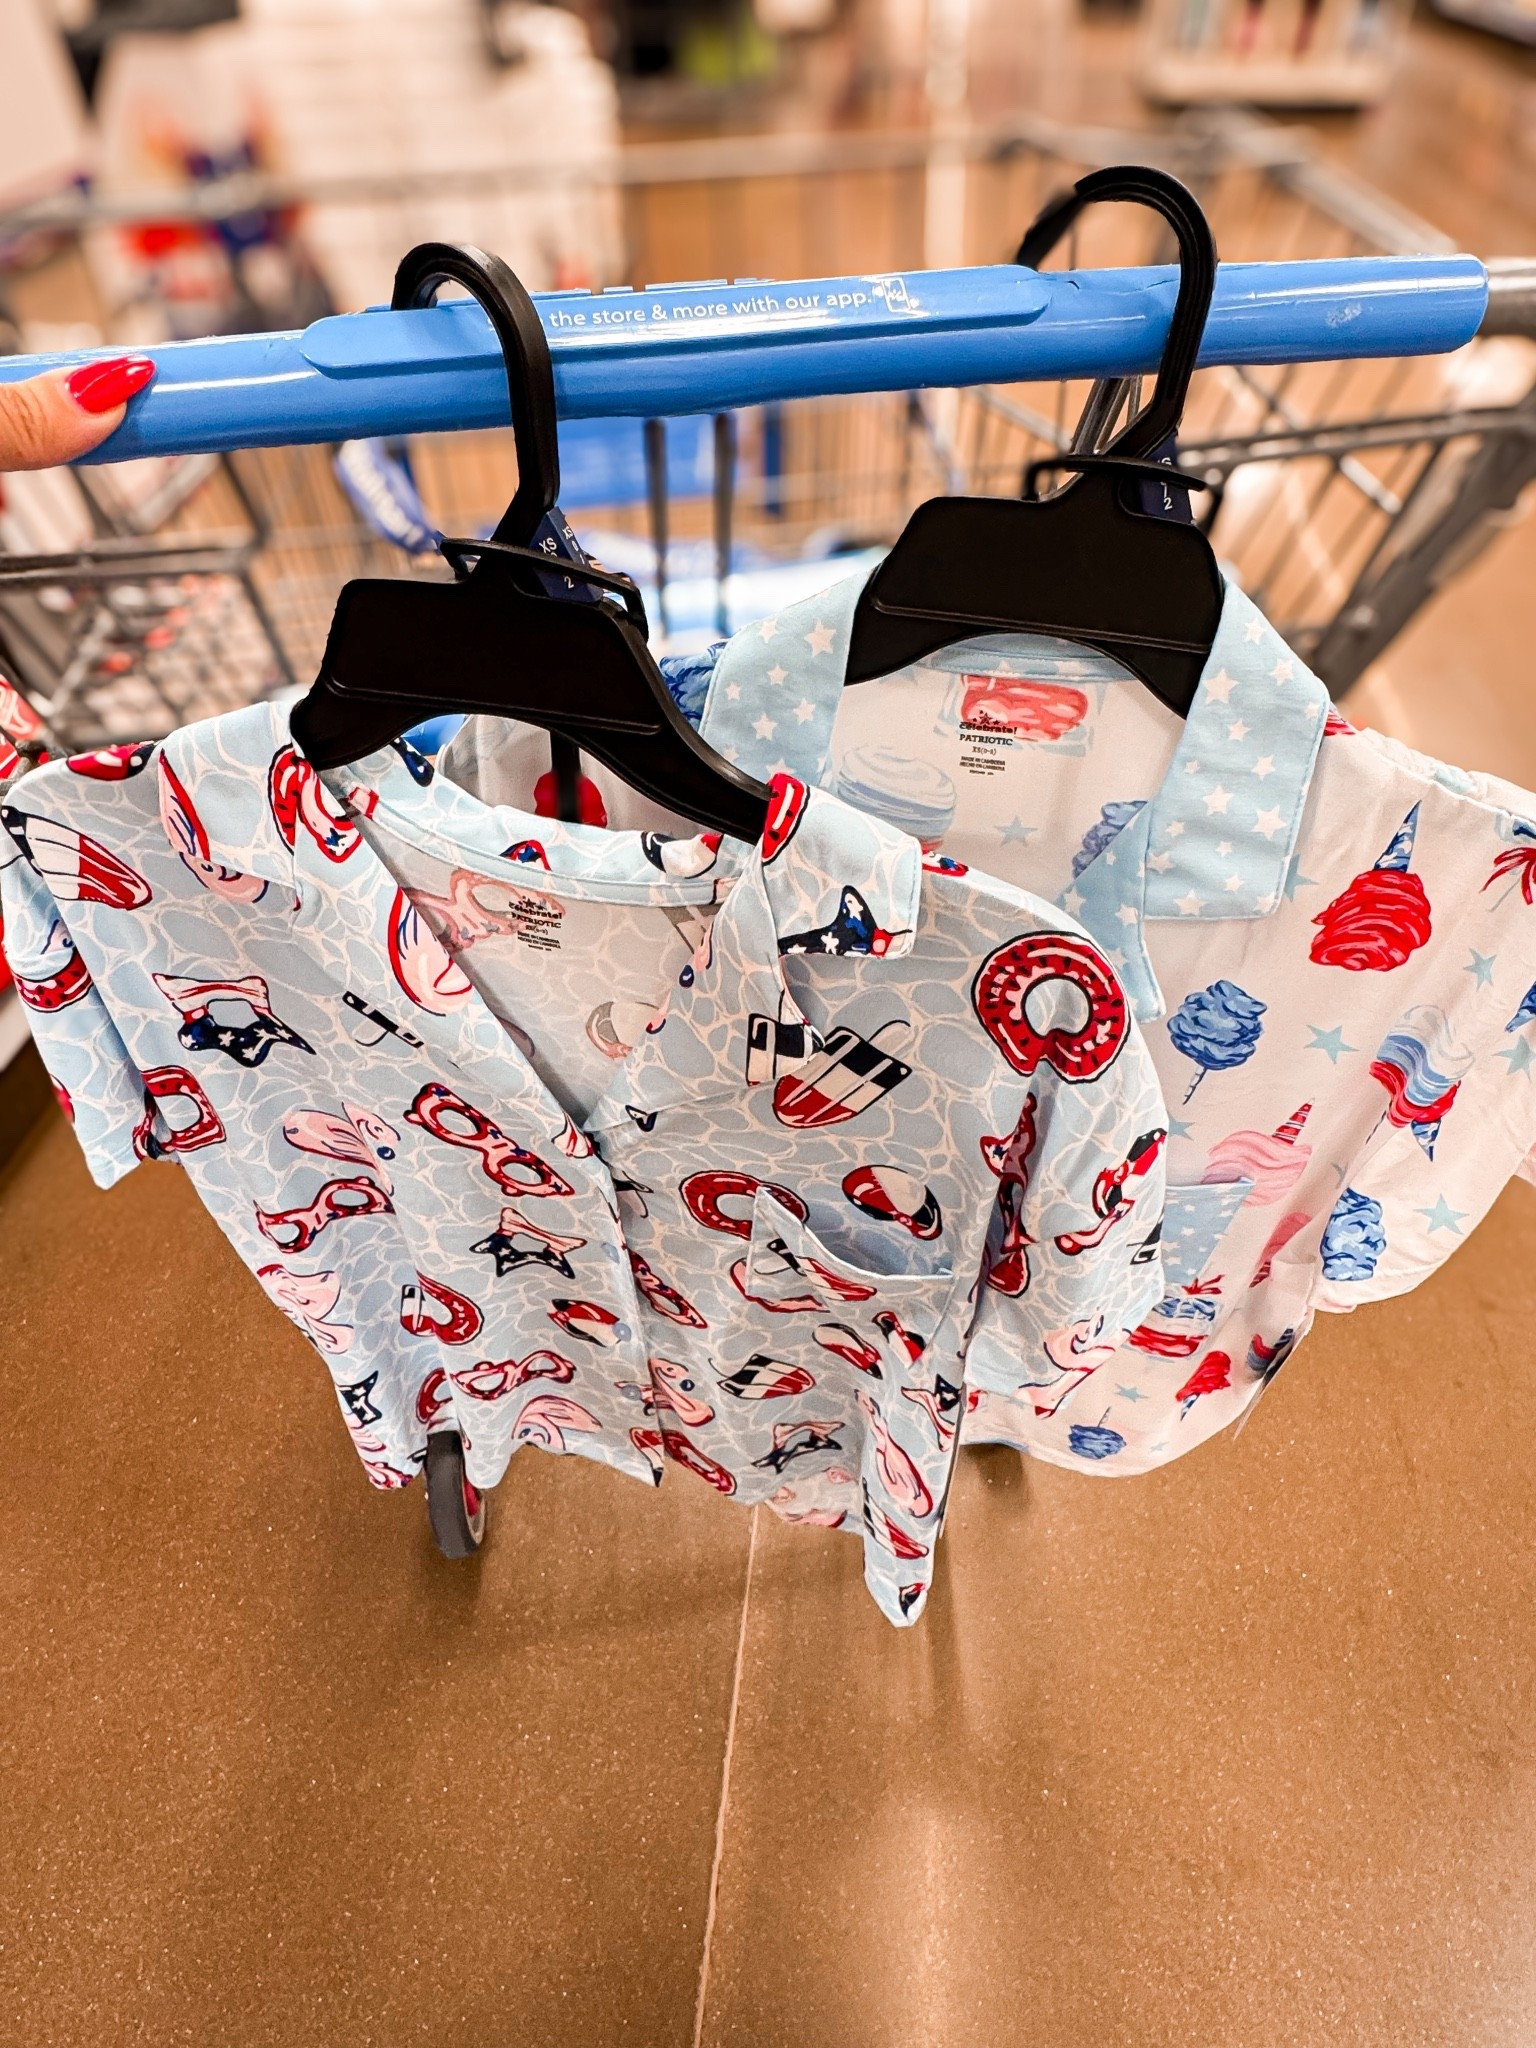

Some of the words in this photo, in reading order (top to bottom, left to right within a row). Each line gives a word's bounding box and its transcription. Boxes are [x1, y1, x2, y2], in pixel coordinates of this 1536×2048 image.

[549, 310, 585, 327] the
[592, 309, 646, 325] store
[652, 304, 668, 320] &
[673, 301, 728, 319] more
[733, 295, 779, 314] with
[785, 295, 820, 310] our
[827, 291, 872, 309] app.
[1163, 497, 1173, 510] 2
[538, 537, 557, 554] XS
[564, 575, 575, 589] 2
[959, 733, 1014, 746] PATRIOTIC
[511, 912, 562, 929] PATRIOTIC
